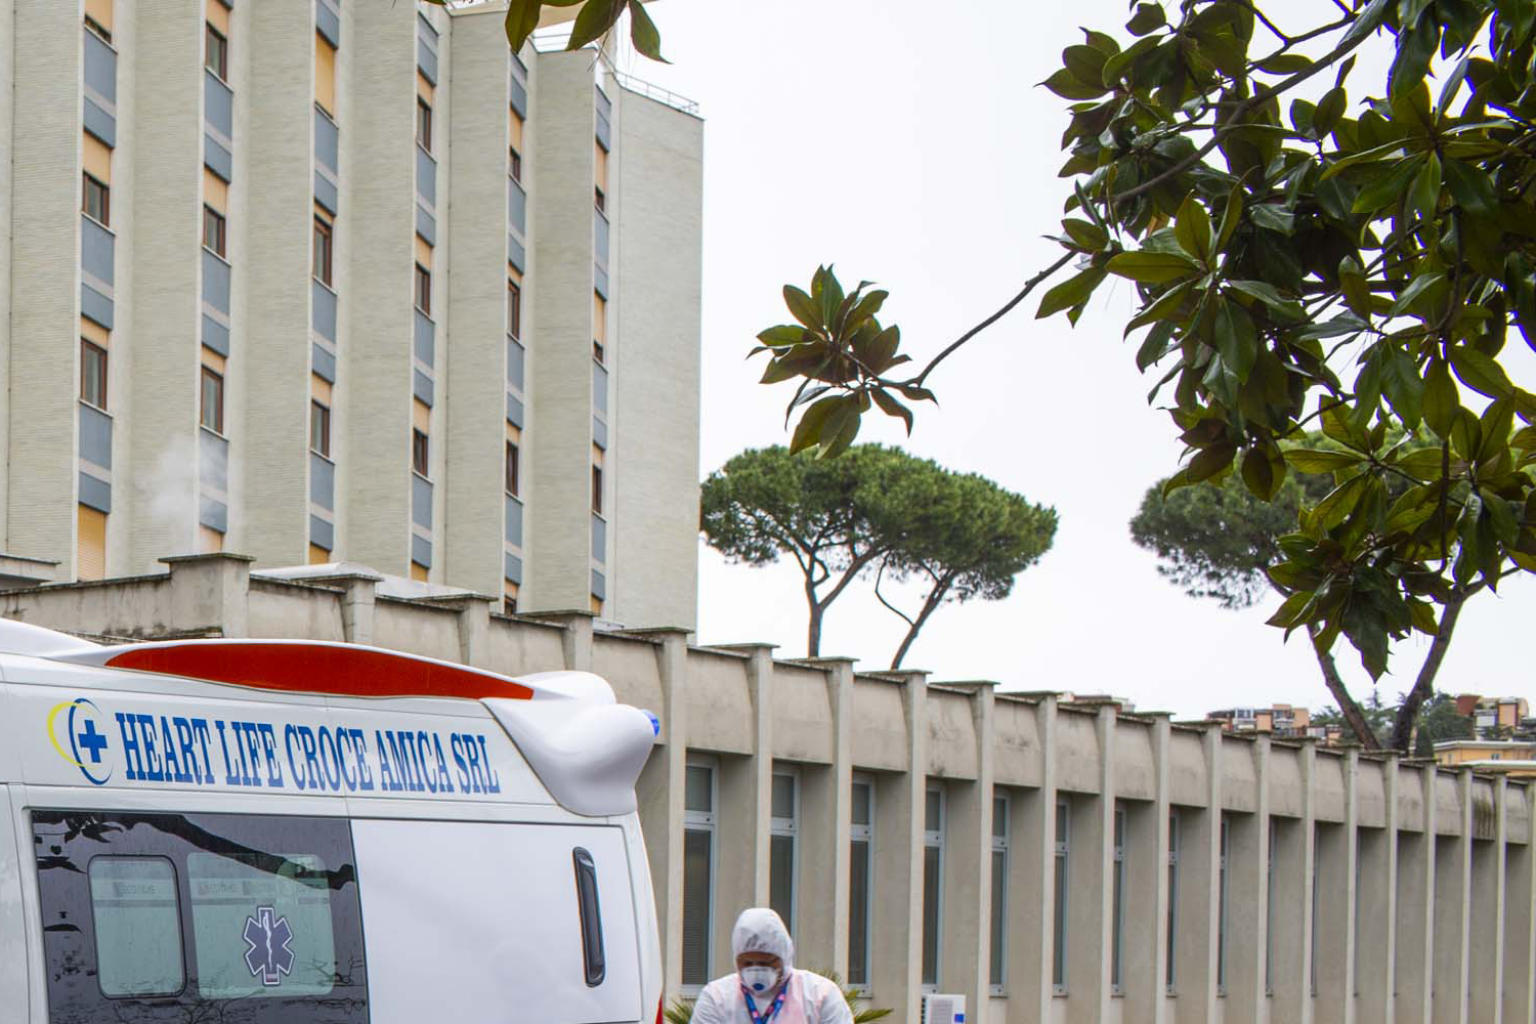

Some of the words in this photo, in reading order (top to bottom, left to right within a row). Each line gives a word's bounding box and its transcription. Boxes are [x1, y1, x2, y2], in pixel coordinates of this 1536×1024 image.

[115, 712, 215, 785] HEART
[216, 719, 284, 786] LIFE
[284, 723, 373, 792] CROCE
[375, 729, 455, 793] AMICA
[451, 732, 500, 794] SRL
